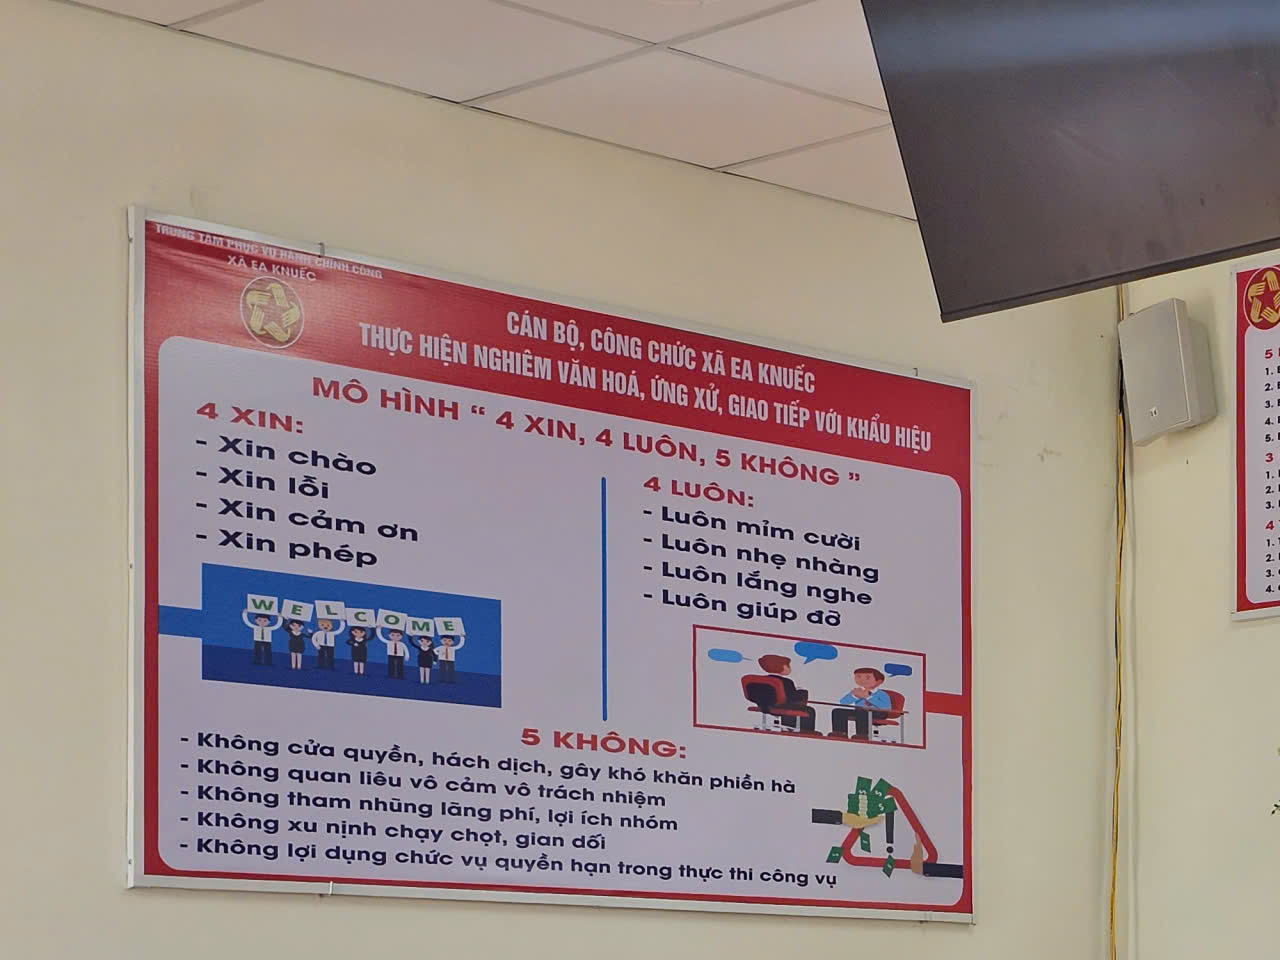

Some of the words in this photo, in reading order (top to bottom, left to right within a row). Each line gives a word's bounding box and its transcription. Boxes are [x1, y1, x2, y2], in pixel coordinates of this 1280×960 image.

[506, 311, 547, 341] CÁN
[553, 320, 585, 351] BỘ,
[590, 328, 642, 360] CÔNG
[647, 339, 696, 370] CHỨC
[701, 349, 726, 376] XÃ
[730, 356, 753, 382] EA
[758, 361, 815, 393] KNUẾC
[1264, 348, 1273, 359] 5
[359, 322, 412, 356] THỰC
[419, 333, 467, 365] HIỆN
[473, 343, 551, 381] NGHIÊM
[557, 358, 596, 389] VĂN
[601, 368, 645, 401] HOÁ,
[650, 374, 688, 407] ỨNG
[693, 386, 723, 416] XỬ,
[728, 393, 769, 421] GIAO
[772, 401, 810, 428] TIẾP
[814, 408, 842, 435] VỚI
[846, 415, 890, 444] KHẨU
[895, 424, 931, 452] HIỆU
[196, 401, 219, 420] 4
[230, 405, 303, 434] XIN:
[312, 376, 368, 404] MÔ
[380, 386, 458, 421] HÌNH
[495, 410, 514, 430] 4
[523, 413, 585, 446] XIN,
[595, 428, 613, 447] 4
[623, 431, 705, 467] LUÔN,
[715, 448, 731, 467] 5
[740, 452, 839, 486] KHÔNG
[218, 435, 275, 460] Xin
[287, 449, 376, 475] chào
[1265, 452, 1274, 463] 3
[218, 466, 275, 491] Xin
[288, 474, 328, 499] lỗi
[643, 476, 661, 492] 4
[671, 479, 754, 508] LUÔN:
[218, 497, 275, 522] Xin
[287, 508, 365, 534] cảm
[377, 523, 418, 542] ơn
[661, 505, 726, 531] Luôn
[736, 519, 794, 541] mỉm
[803, 531, 860, 551] cười
[1265, 520, 1275, 530] 4
[218, 528, 275, 553] Xin
[288, 541, 378, 568] phép
[661, 533, 726, 558] Luôn
[736, 547, 787, 570] nhẹ
[795, 555, 879, 584] nhàng
[1266, 538, 1275, 547] 1.
[520, 727, 541, 746] 5
[553, 730, 686, 759] KHÔNG:
[197, 811, 279, 835] Không
[287, 820, 317, 833] xu
[326, 820, 376, 836] nịnh
[384, 823, 443, 843] chạy
[450, 827, 507, 846] chọt,
[515, 831, 564, 849] gian
[571, 833, 605, 850] dối
